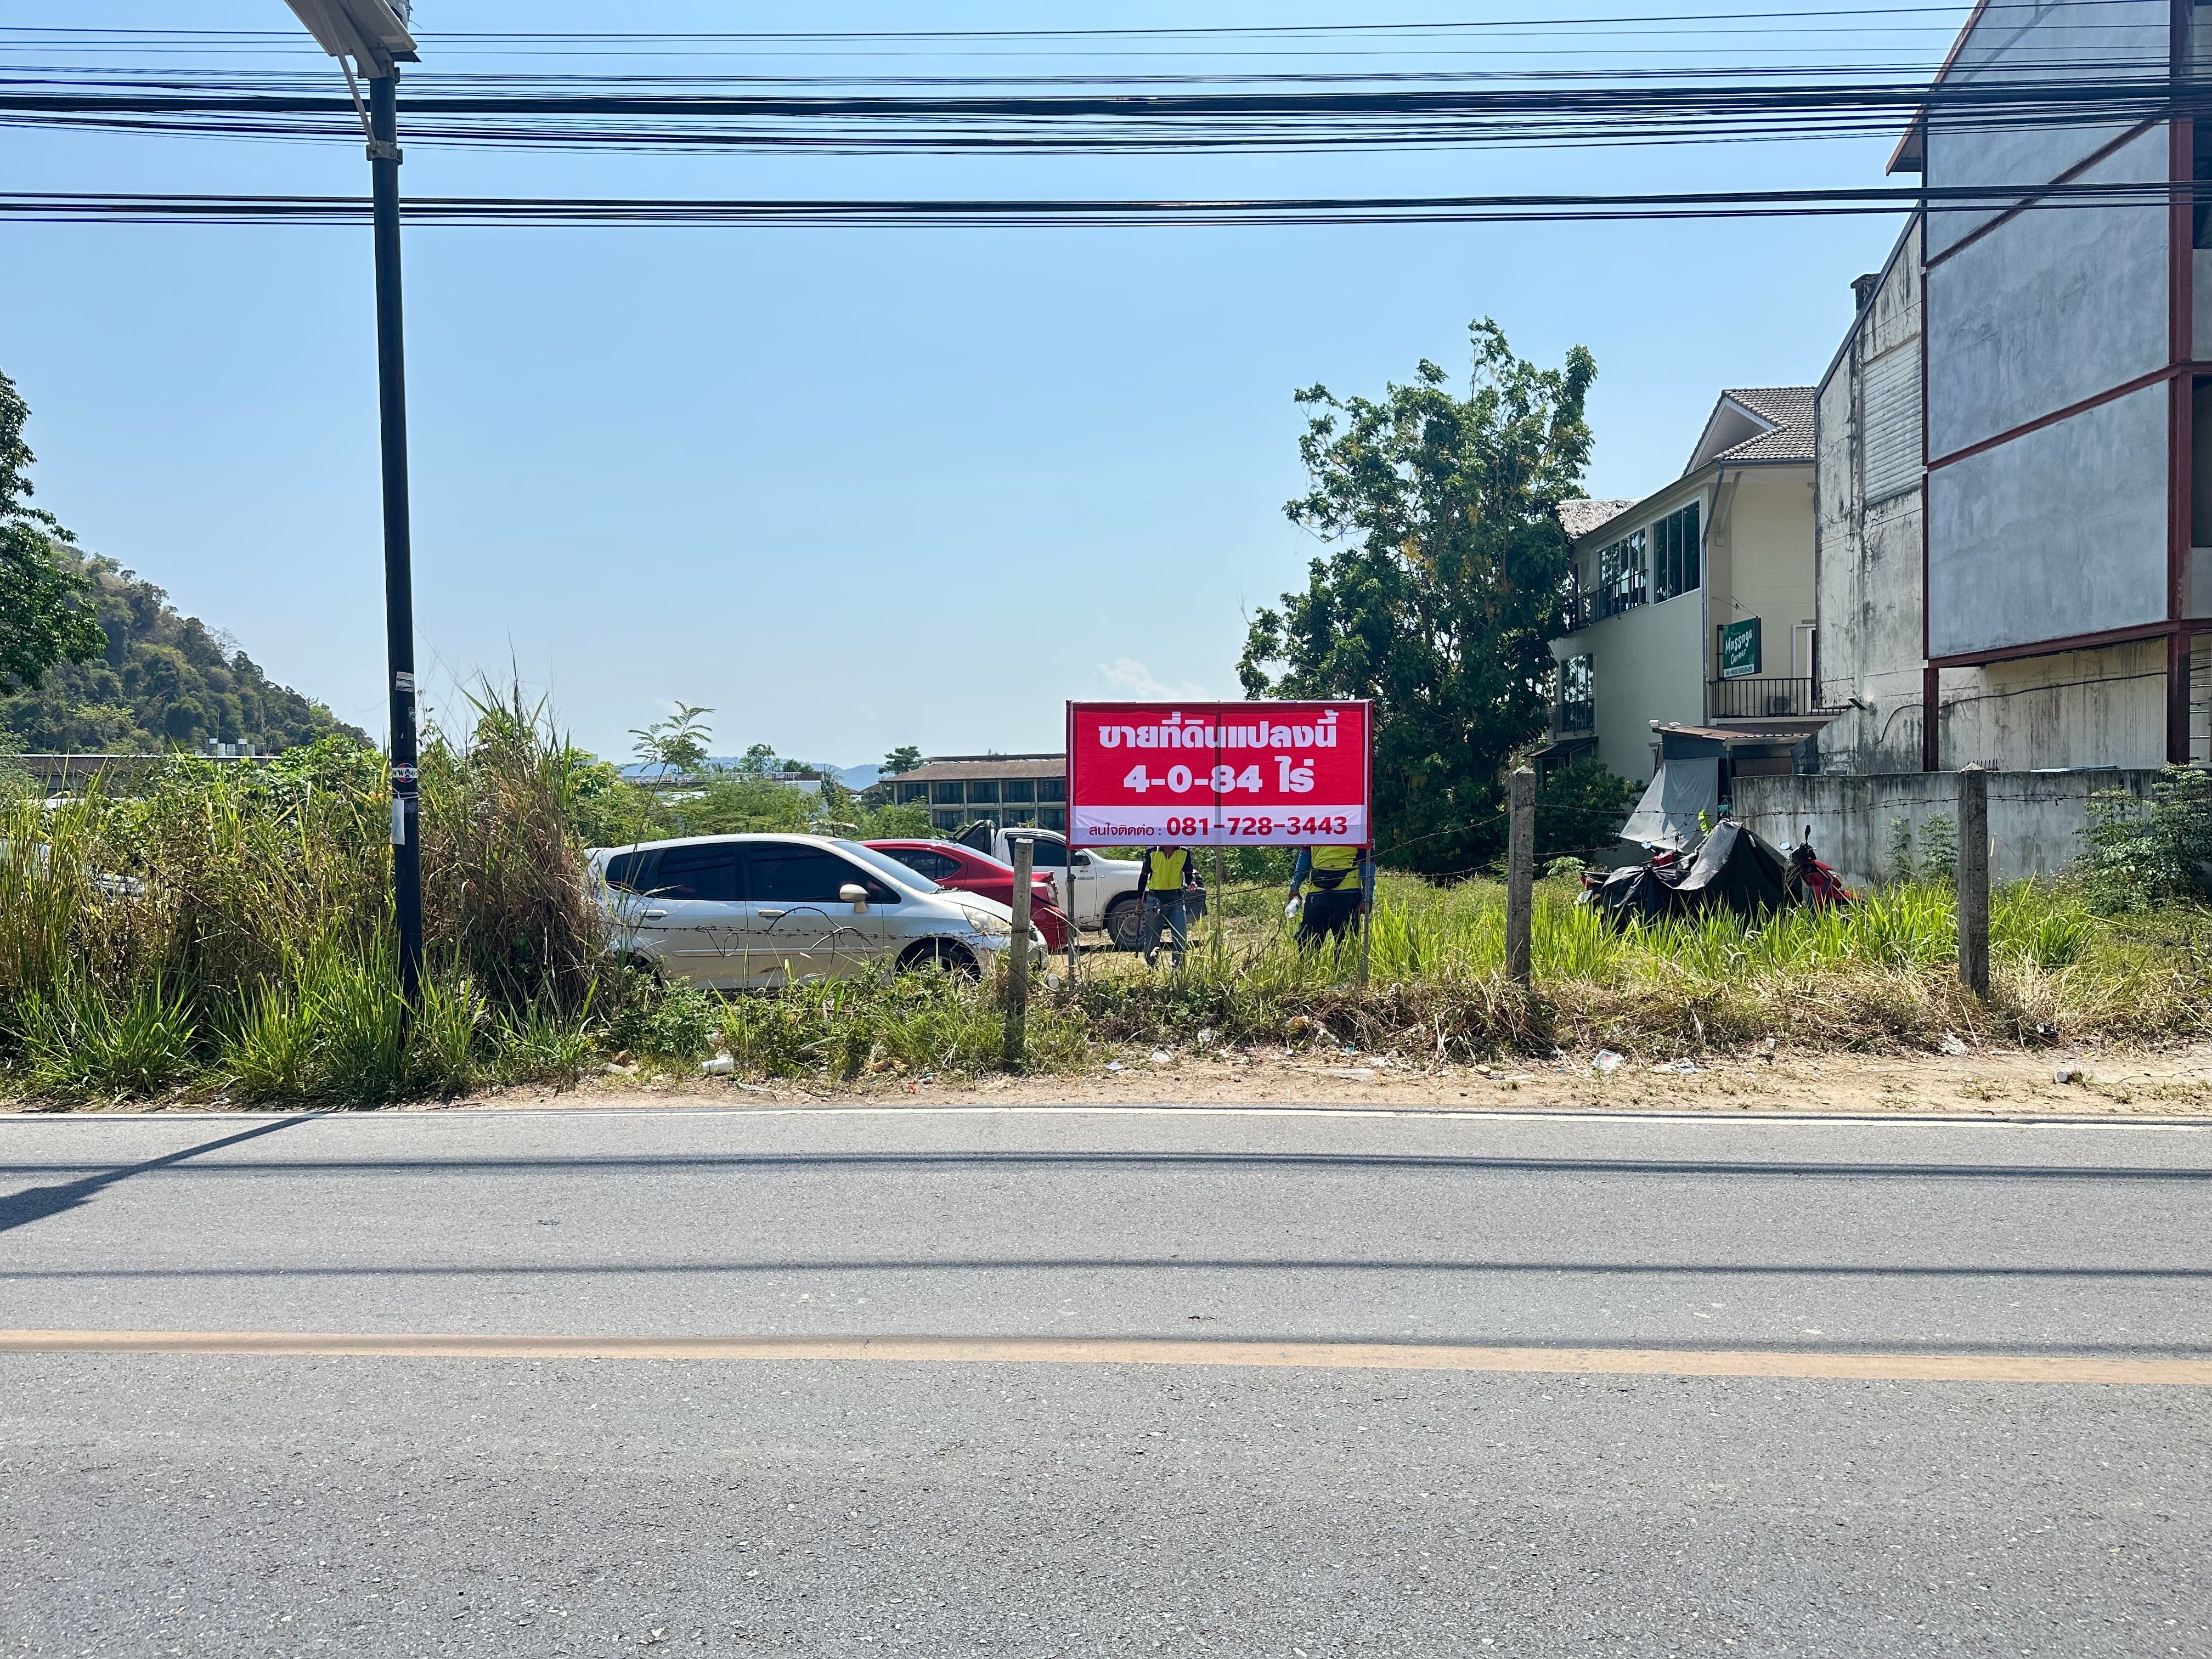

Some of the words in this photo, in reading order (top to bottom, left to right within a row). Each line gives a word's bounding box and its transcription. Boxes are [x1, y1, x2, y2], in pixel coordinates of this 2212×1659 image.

[1725, 629, 1753, 654] Massage
[1730, 648, 1747, 665] Corner
[1099, 709, 1339, 748] ขายที่ดินแปลงนี้
[1123, 765, 1263, 793] 4-0-84
[1274, 755, 1315, 793] ไร่
[1166, 816, 1347, 836] 081-728-3443
